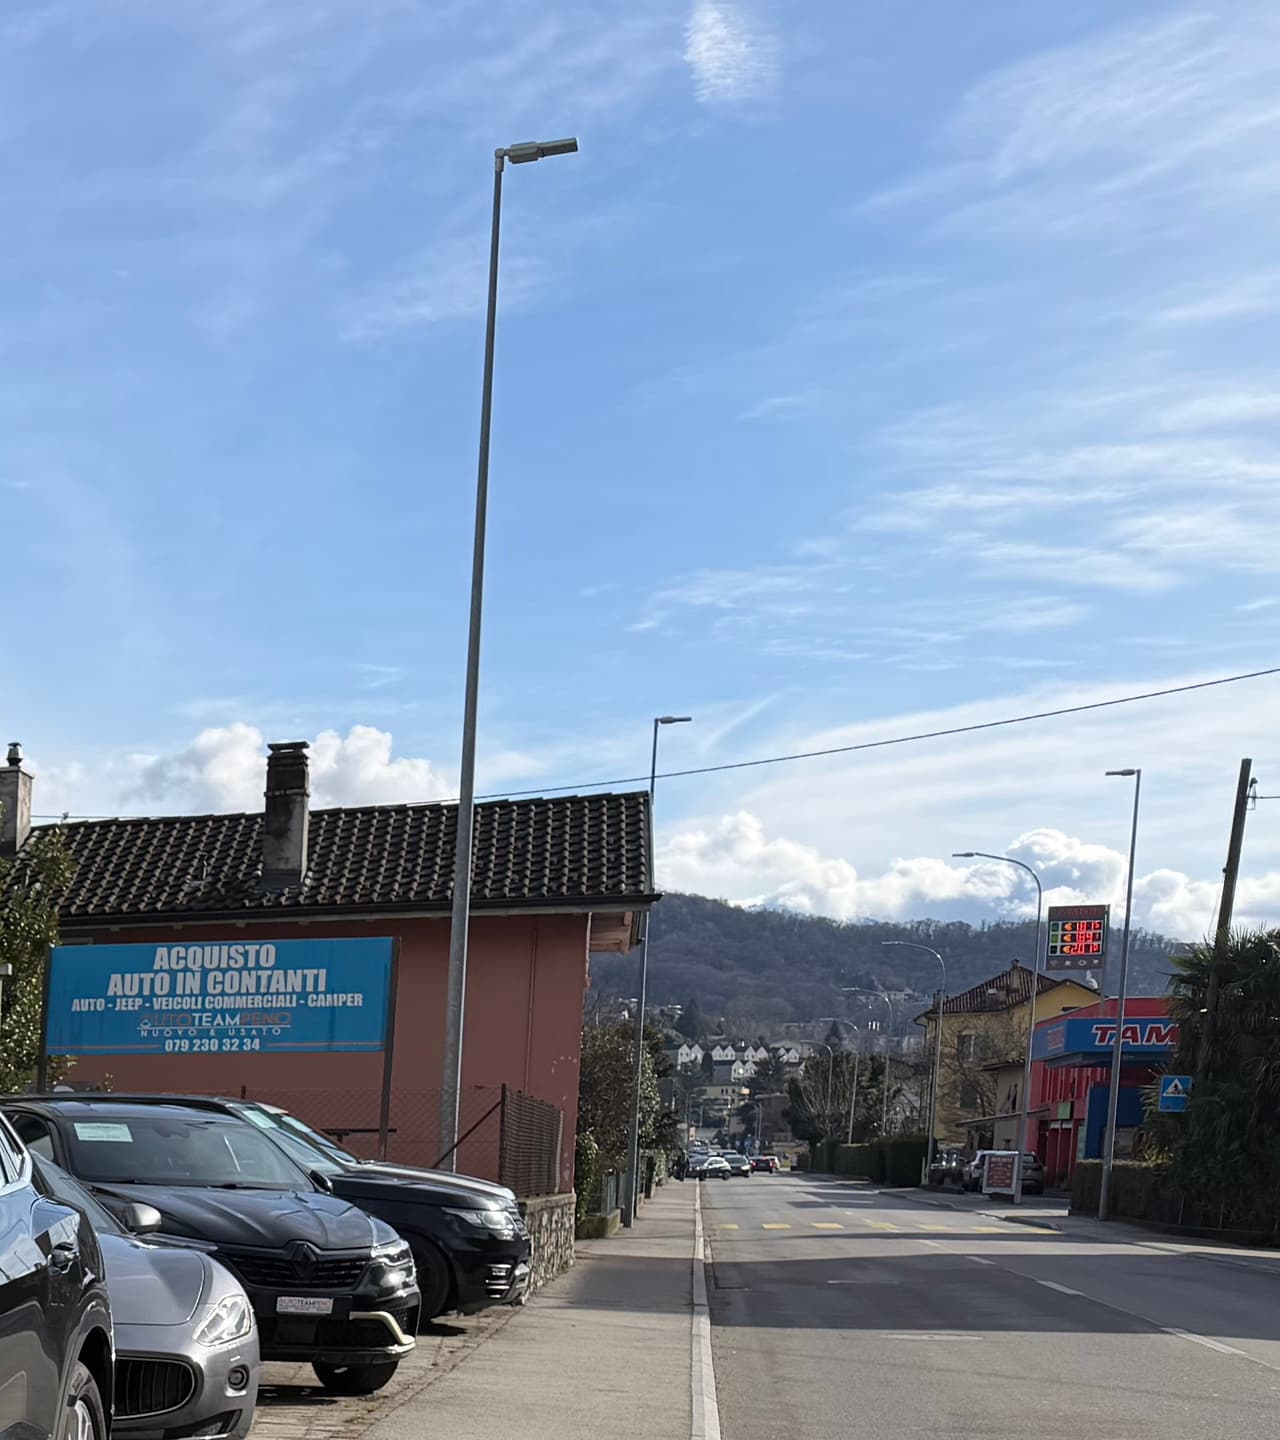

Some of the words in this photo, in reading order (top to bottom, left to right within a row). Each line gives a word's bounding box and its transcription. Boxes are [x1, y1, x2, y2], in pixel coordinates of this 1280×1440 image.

[153, 944, 276, 971] ACQUISTO
[107, 973, 170, 997] AUTO
[175, 971, 202, 995] IN
[206, 968, 328, 995] CONTANTI
[71, 998, 106, 1012] AUTO
[114, 998, 143, 1011] JEEP
[153, 996, 202, 1010] VEICOLI
[205, 994, 297, 1009] COMMERCIALI
[307, 993, 363, 1007] CAMPER
[140, 1028, 197, 1038] NUOVO
[228, 1027, 281, 1036] USATO
[1092, 1024, 1180, 1046] TAM
[164, 1040, 189, 1052] 079
[192, 1039, 219, 1052] 230
[222, 1038, 239, 1051] 32
[242, 1038, 260, 1051] 34
